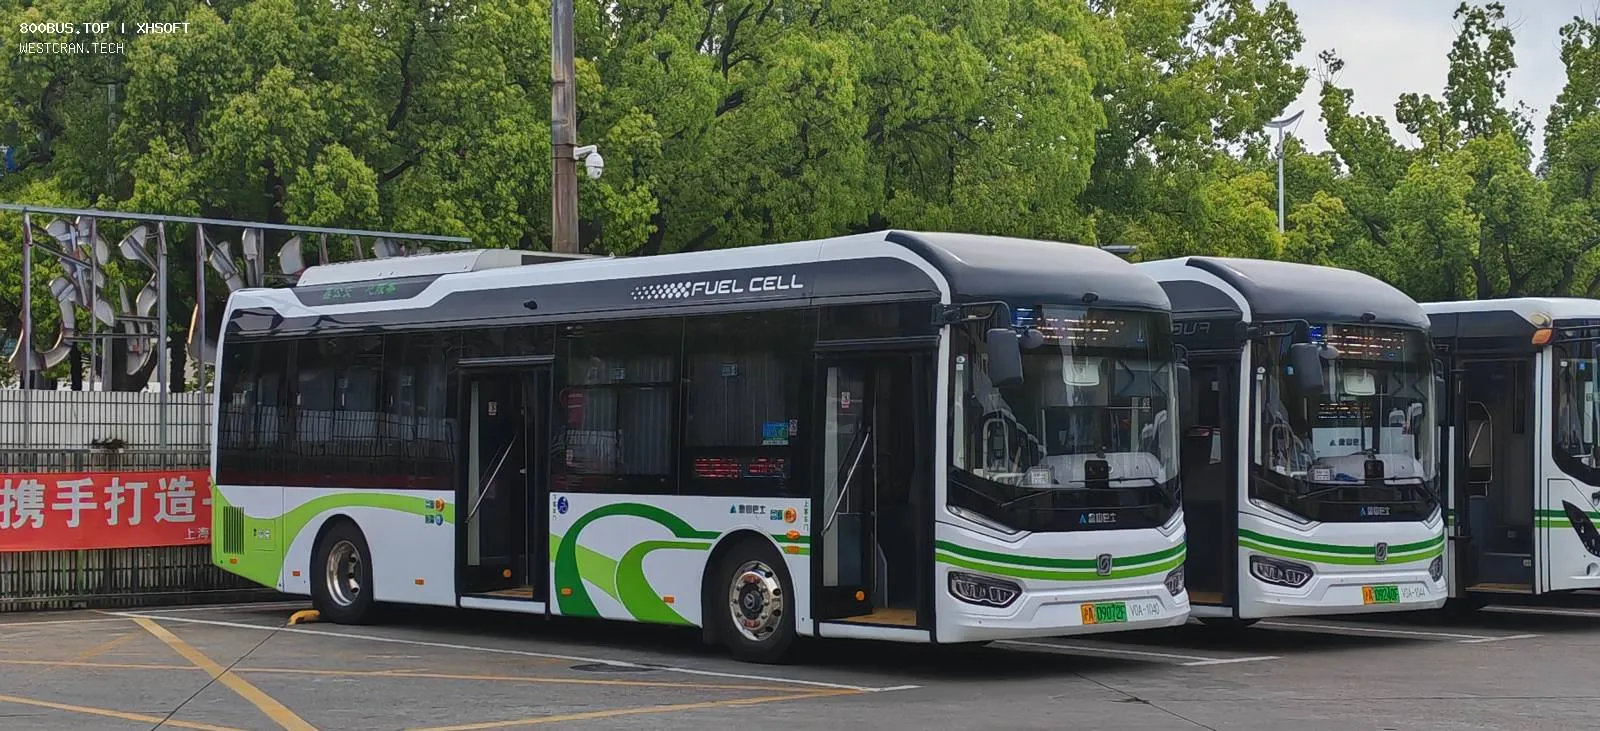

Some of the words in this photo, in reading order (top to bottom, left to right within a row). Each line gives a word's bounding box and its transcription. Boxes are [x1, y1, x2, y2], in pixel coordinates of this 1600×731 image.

[691, 279, 744, 297] FUEL
[748, 274, 804, 292] CELL
[0, 476, 212, 529] 携手打造
